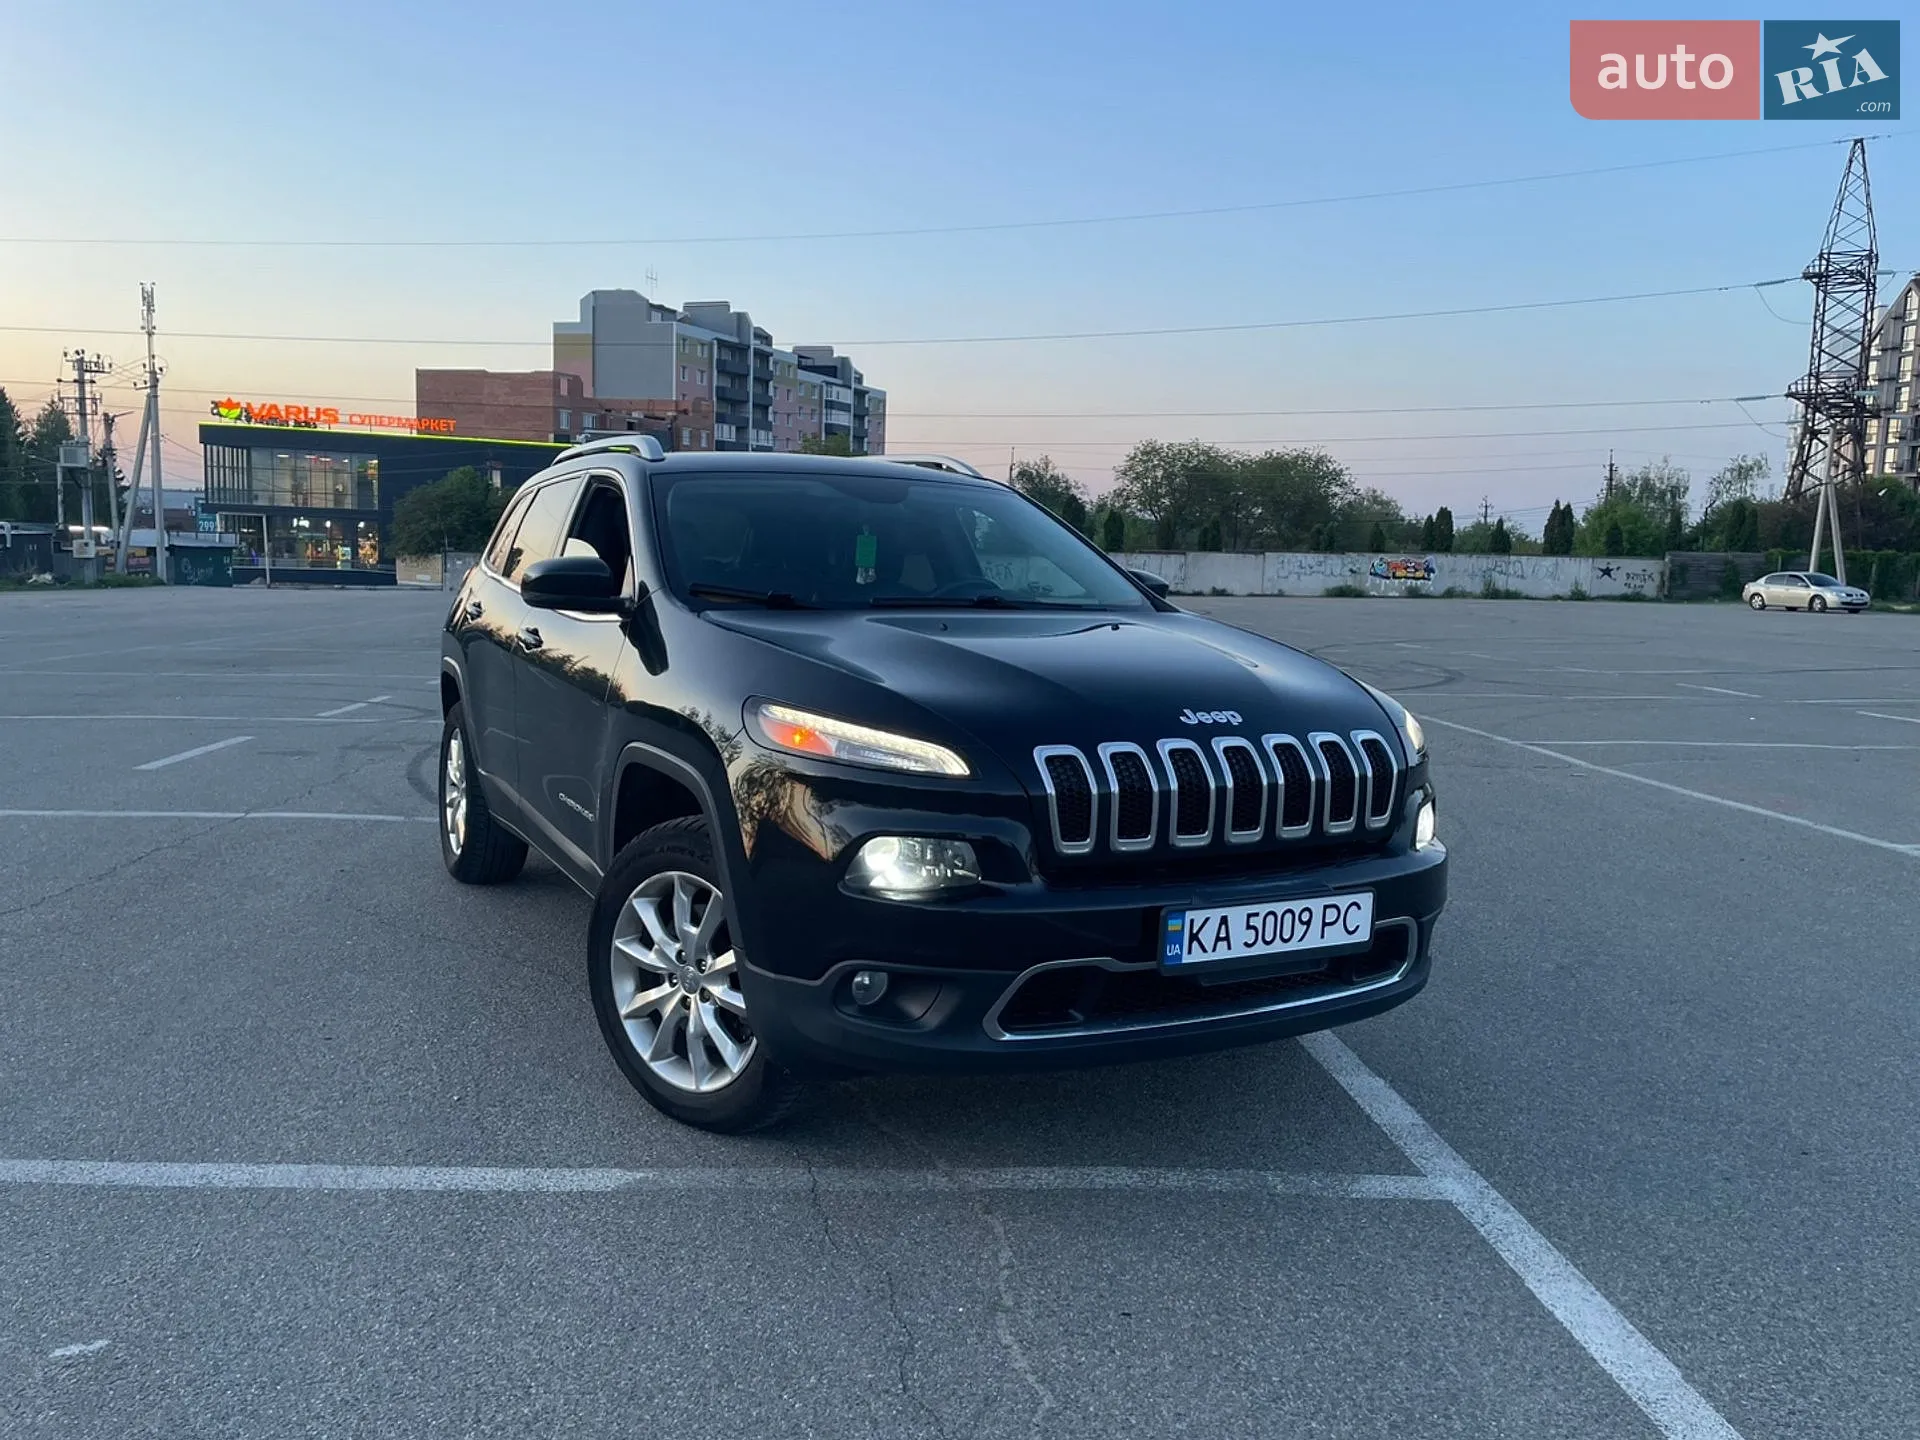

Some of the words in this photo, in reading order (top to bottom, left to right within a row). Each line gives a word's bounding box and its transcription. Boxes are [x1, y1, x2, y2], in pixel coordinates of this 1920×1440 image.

[246, 402, 340, 424] VARUS
[198, 520, 216, 532] 299
[1179, 708, 1243, 726] Jeep
[1187, 915, 1231, 955] KA
[1242, 906, 1313, 948] 5009
[1319, 901, 1361, 939] PC
[1166, 944, 1181, 956] UA
